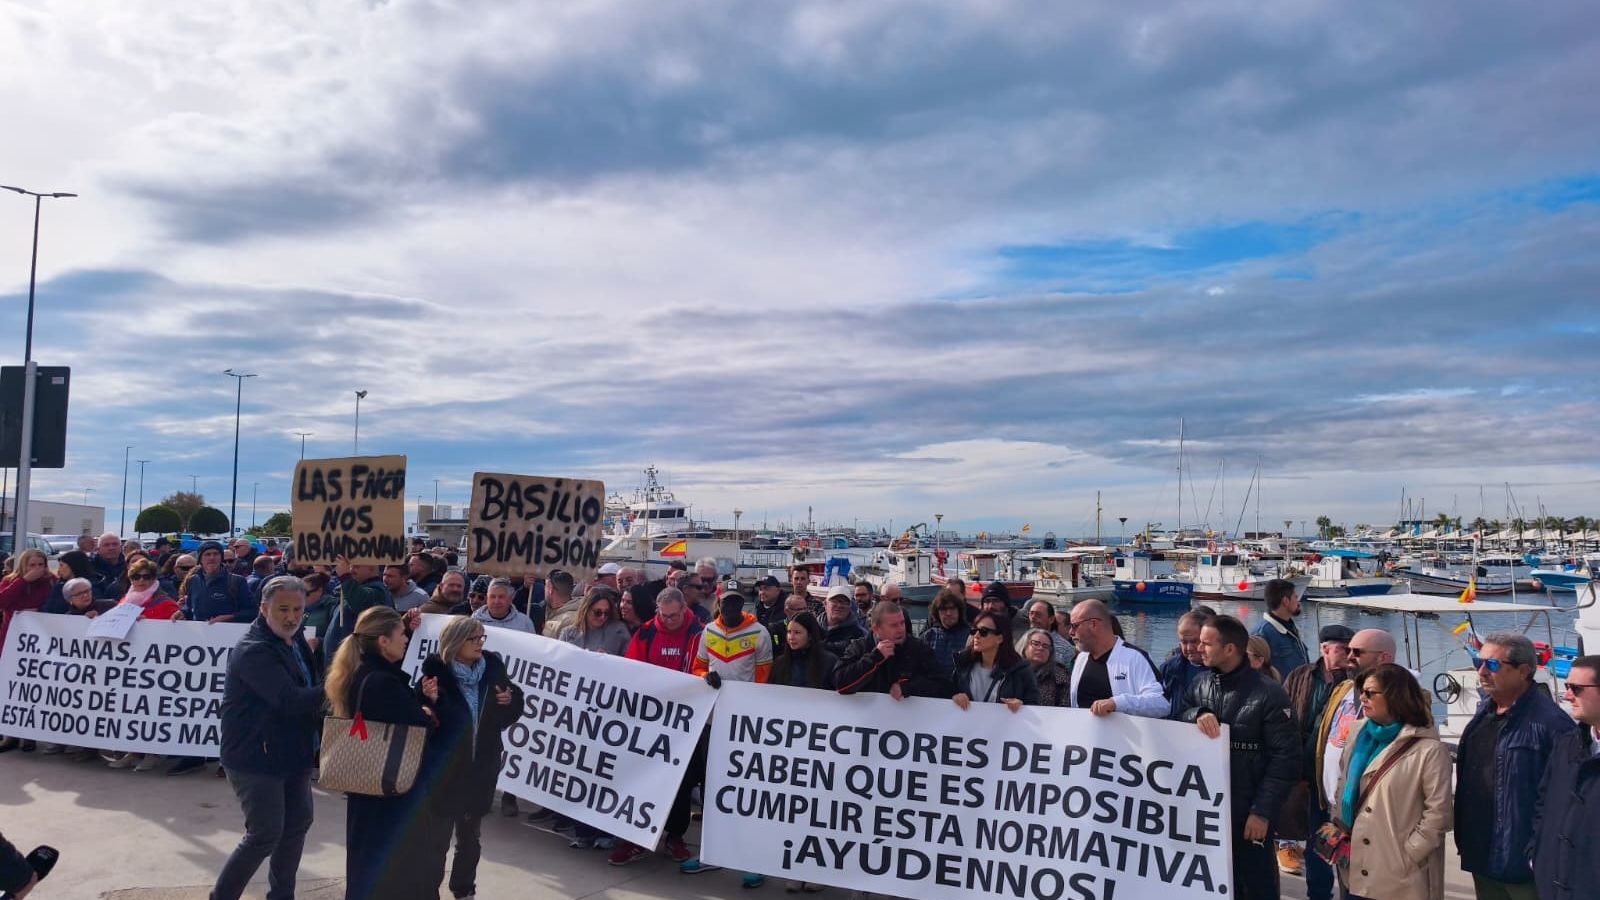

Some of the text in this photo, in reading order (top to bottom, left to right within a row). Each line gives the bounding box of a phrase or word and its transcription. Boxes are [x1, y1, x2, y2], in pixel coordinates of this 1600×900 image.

[298, 466, 343, 502] LAS
[321, 504, 373, 534] NOS
[297, 531, 405, 562] ABANDONAN
[16, 632, 234, 668] SR. PLANAS, APOY
[16, 657, 97, 686] SECTOR
[8, 680, 18, 700] Y
[18, 682, 42, 704] NO
[46, 685, 84, 710] NOS
[88, 688, 118, 713] DÉ
[122, 693, 150, 716] LA
[574, 676, 694, 733] HUNDIR
[1, 704, 36, 729] ESTÁ
[40, 709, 90, 735] TODO
[94, 716, 122, 739] EN
[126, 719, 172, 744] SUS
[520, 692, 681, 767] SPAÑOLA.
[729, 714, 1224, 807] INSPECTORES DE PESCA,
[1230, 741, 1259, 751] UESS
[525, 759, 659, 834] MEDIDAS.
[726, 749, 1221, 847] SABEN QUE ES IMPOSIBLE
[715, 784, 1228, 895] CUMPLIR ESTA NORMATIVA.
[781, 834, 1116, 900] ¡AYÚDENNOS!
